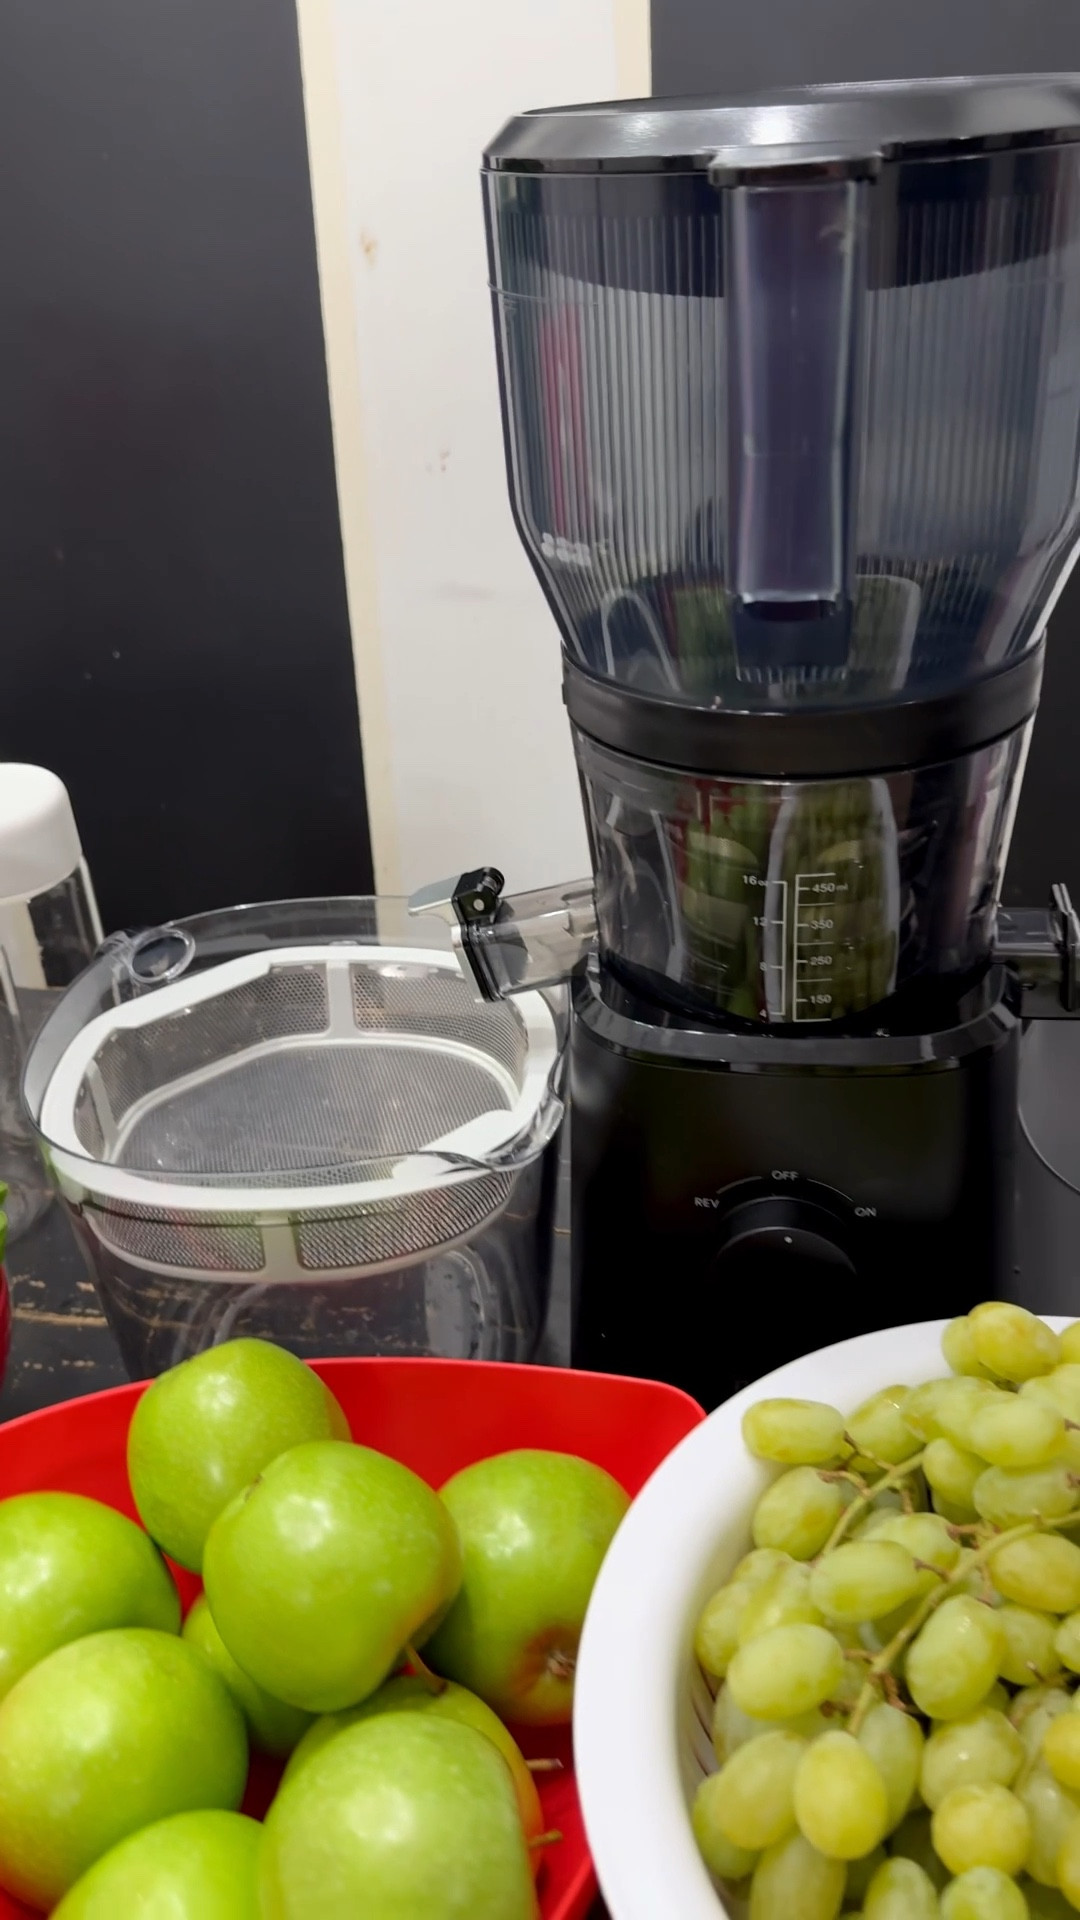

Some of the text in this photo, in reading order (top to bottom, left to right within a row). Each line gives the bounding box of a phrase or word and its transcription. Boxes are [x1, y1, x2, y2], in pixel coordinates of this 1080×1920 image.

[809, 918, 834, 930] 350
[810, 955, 832, 966] 250
[810, 994, 832, 1004] 150
[771, 1169, 799, 1182] OFF
[694, 1196, 720, 1210] REV
[854, 1206, 877, 1218] ON
